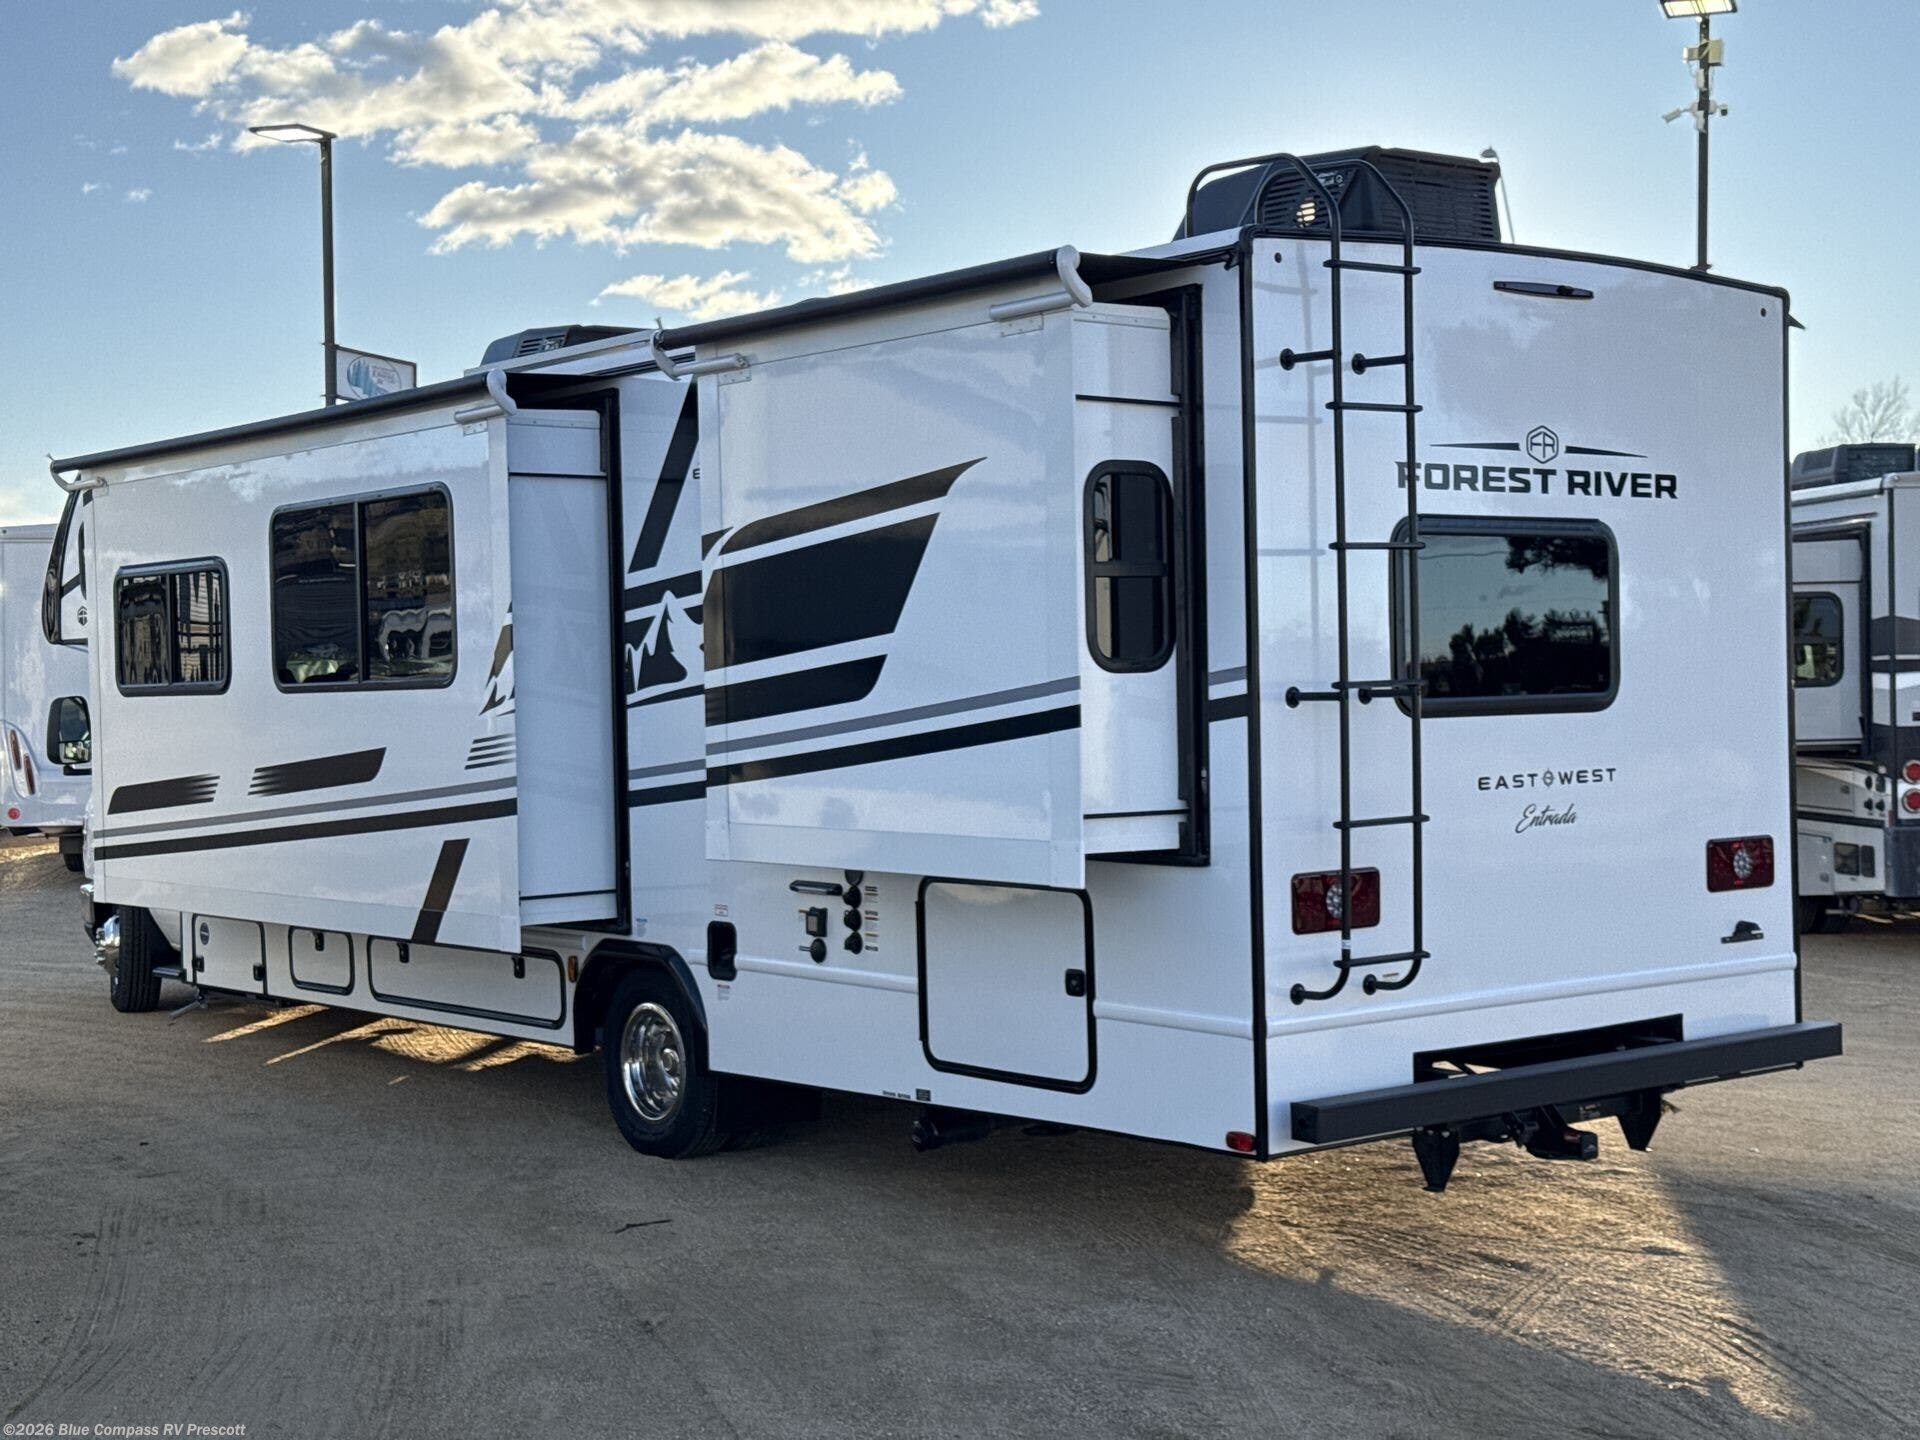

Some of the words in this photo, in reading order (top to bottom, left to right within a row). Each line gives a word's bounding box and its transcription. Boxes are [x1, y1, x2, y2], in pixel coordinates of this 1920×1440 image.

[1395, 461, 1557, 494] FOREST
[1566, 470, 1678, 499] RIVER
[1478, 773, 1538, 790] EAST
[1558, 768, 1616, 785] WEST
[1515, 803, 1577, 833] Entrada
